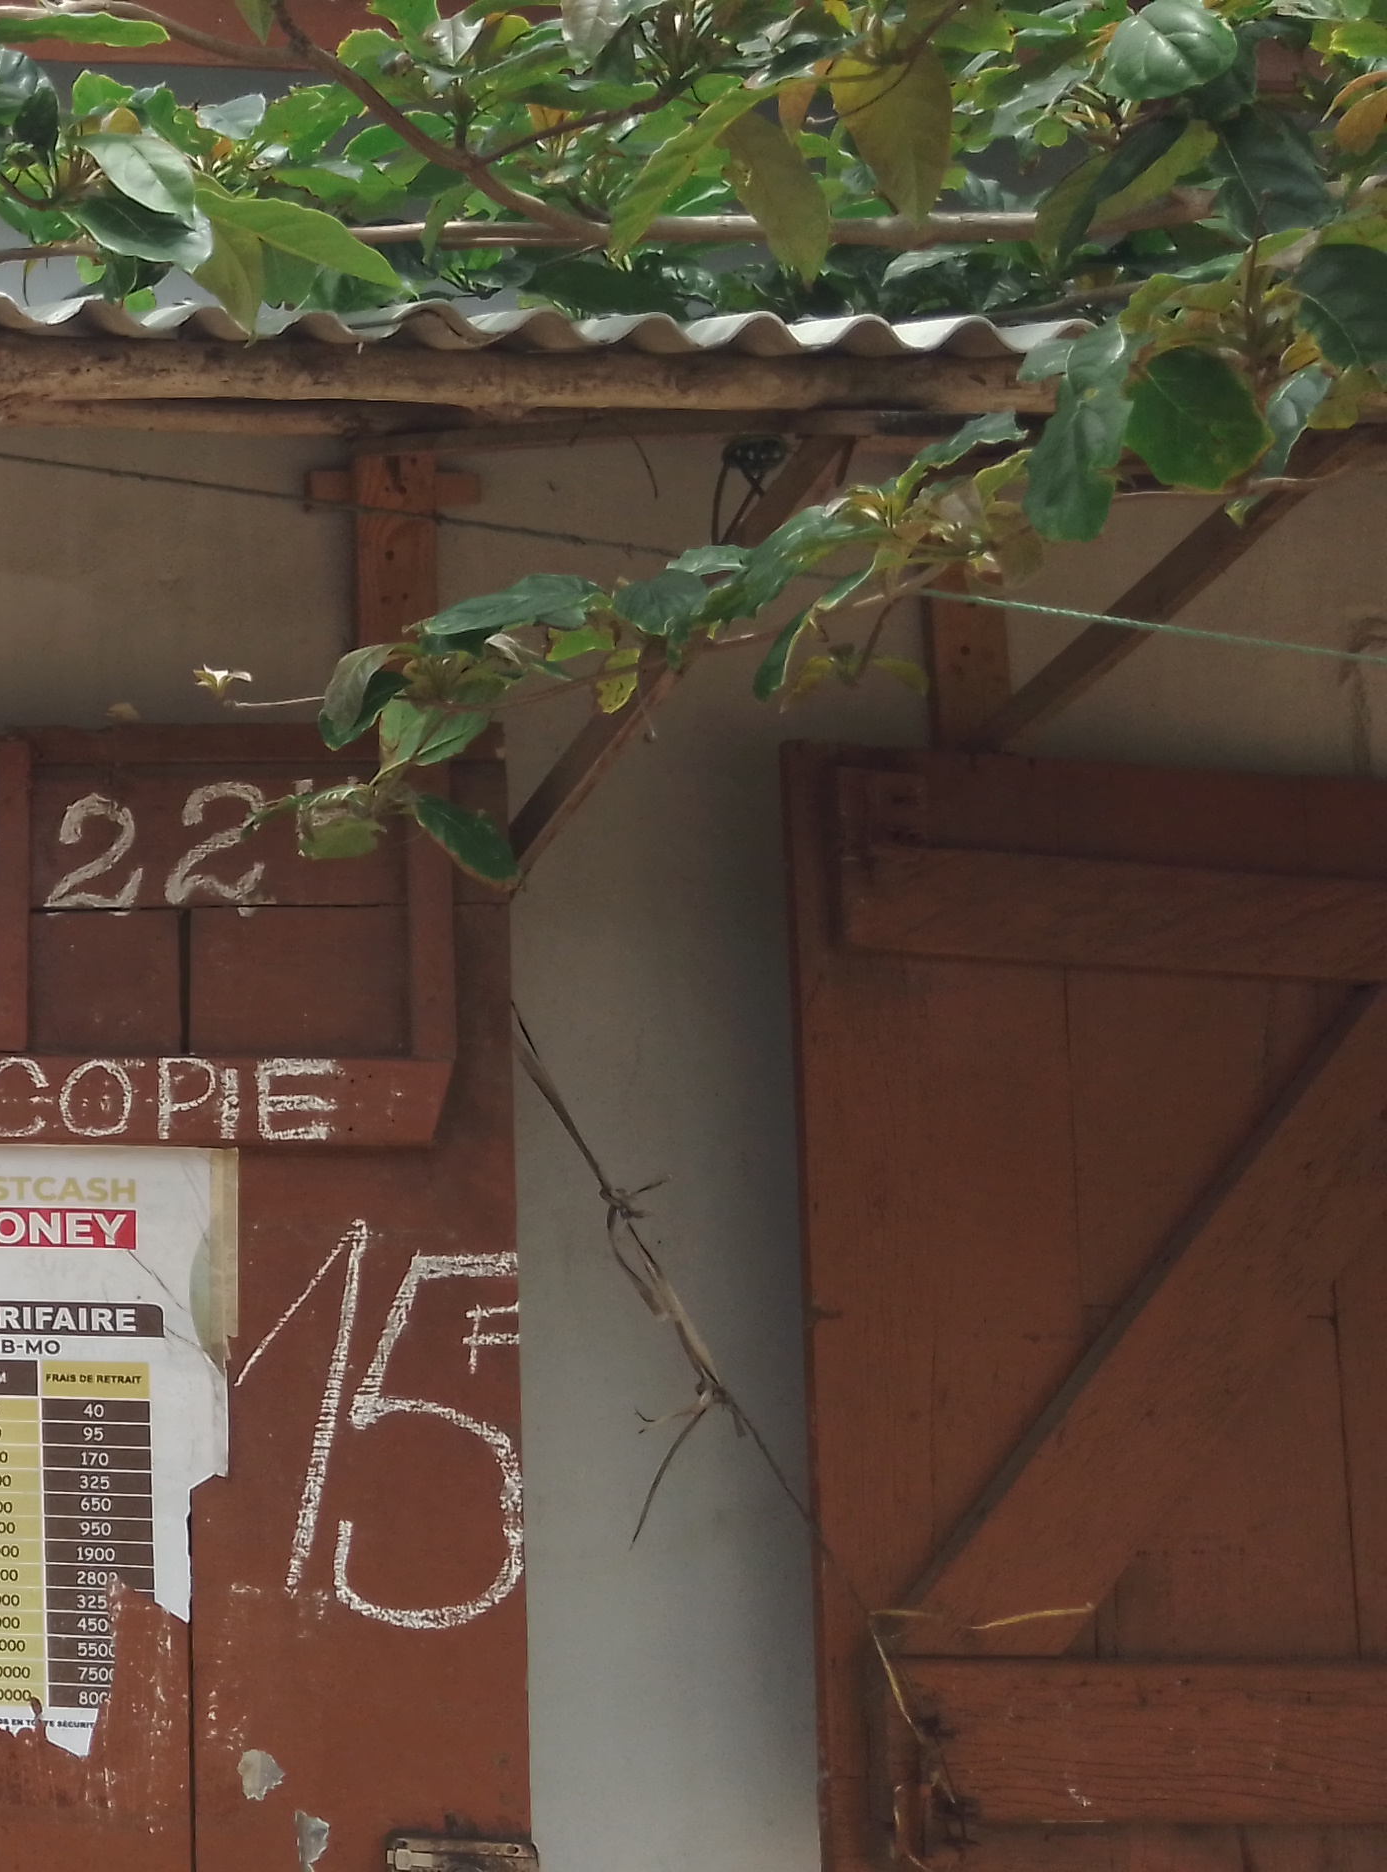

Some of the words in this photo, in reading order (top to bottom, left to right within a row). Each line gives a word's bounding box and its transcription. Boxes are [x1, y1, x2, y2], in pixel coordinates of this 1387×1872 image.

[43, 782, 266, 916] 22
[1, 1339, 61, 1355] B-MO
[46, 1373, 77, 1383] FRAIS
[79, 1374, 94, 1383] DE
[96, 1374, 142, 1385] RETRAIT
[83, 1404, 105, 1418] 40
[234, 1216, 525, 1630] 15
[83, 1427, 104, 1441] 95
[81, 1452, 109, 1466] 170
[79, 1476, 110, 1490] 325
[81, 1497, 111, 1512] 650
[80, 1522, 111, 1536] 950
[77, 1547, 116, 1561] 1900
[77, 1595, 107, 1609] 325
